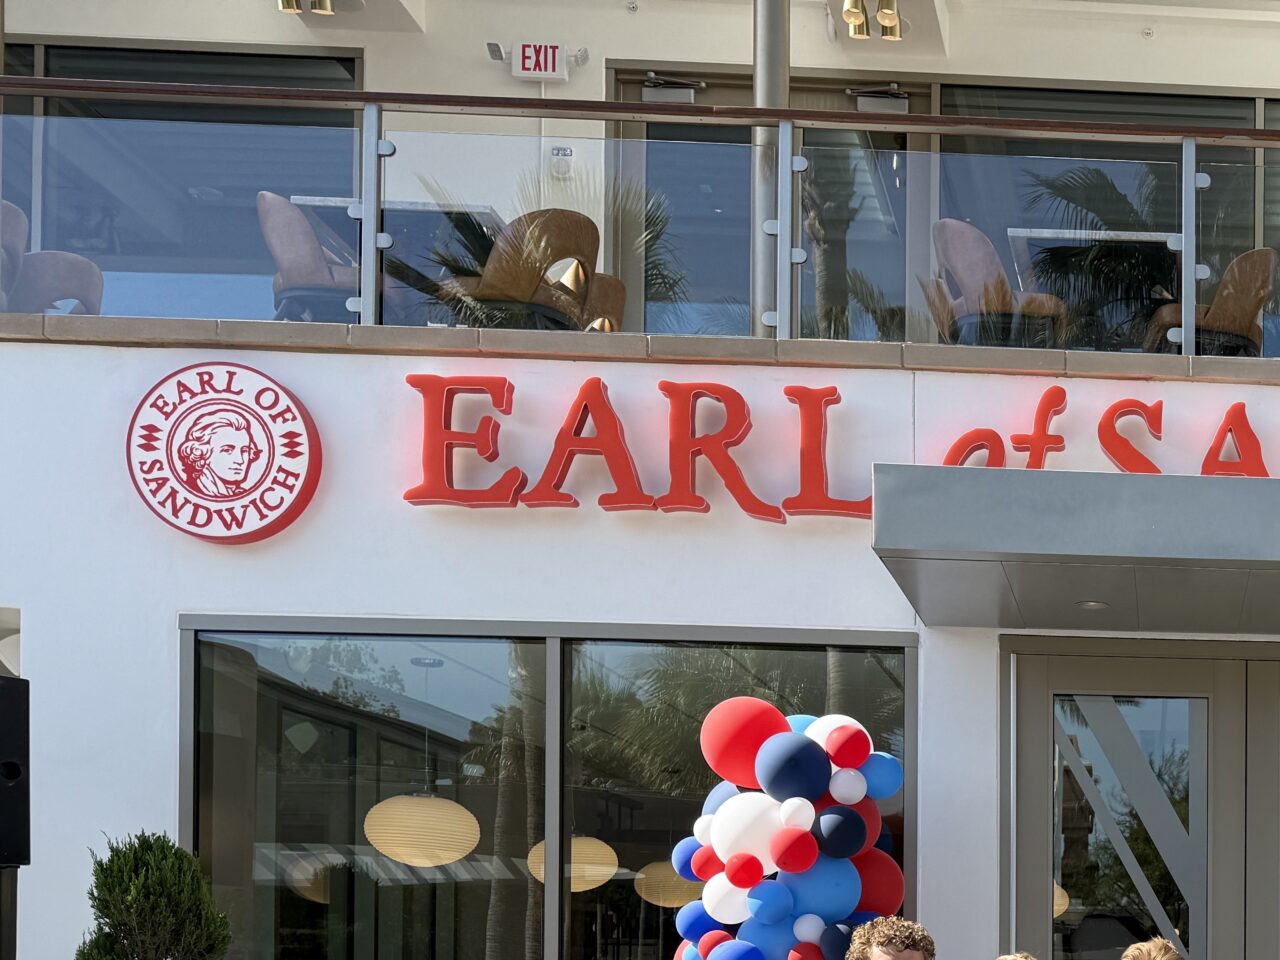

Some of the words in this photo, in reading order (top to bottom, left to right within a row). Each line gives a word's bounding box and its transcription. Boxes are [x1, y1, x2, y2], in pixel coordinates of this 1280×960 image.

[521, 44, 559, 73] EXIT
[150, 370, 244, 421] EARL
[254, 387, 298, 425] OF
[403, 374, 873, 525] EARL
[139, 459, 301, 532] SANDWICH
